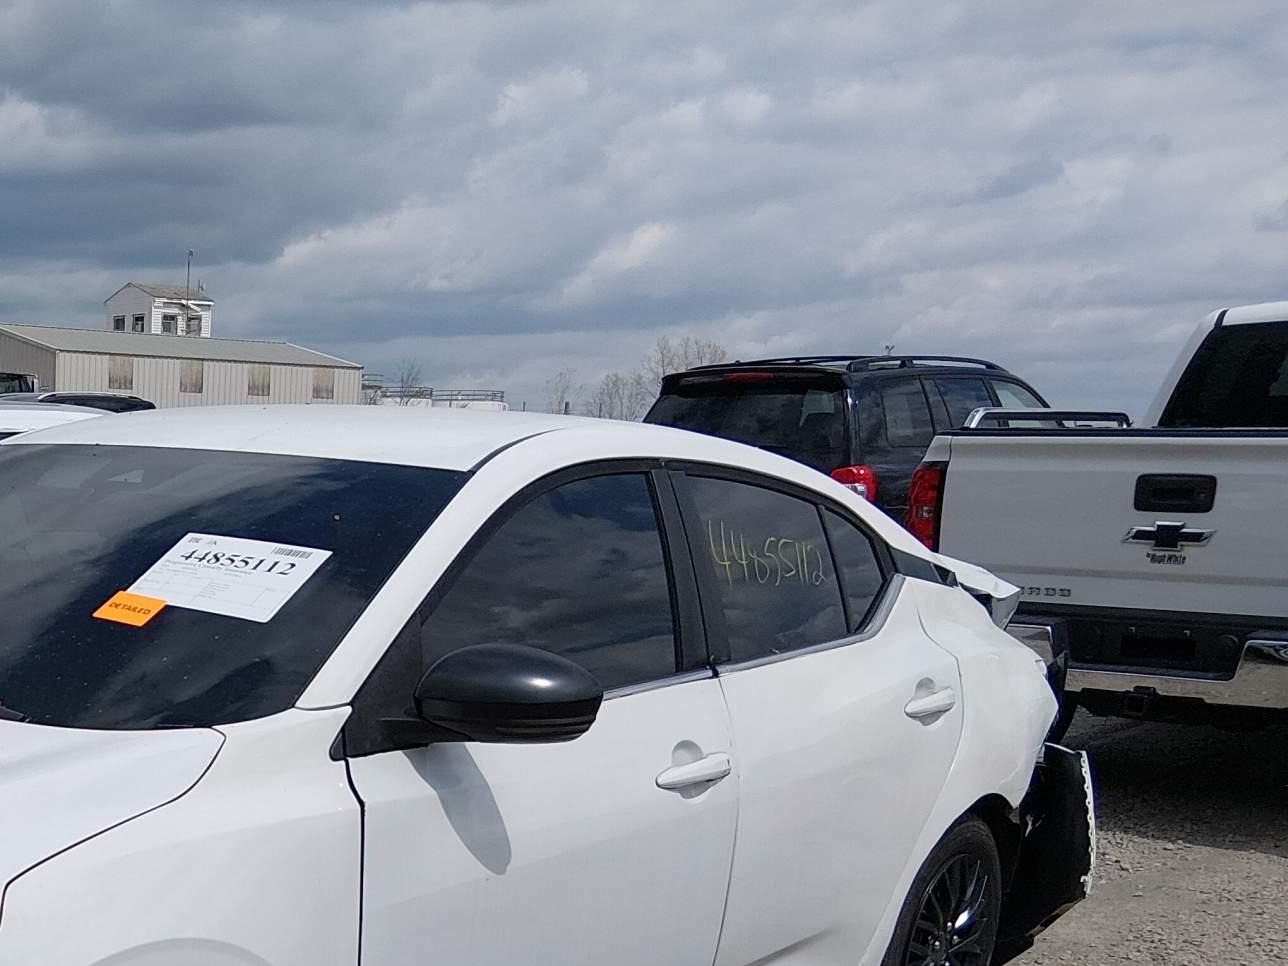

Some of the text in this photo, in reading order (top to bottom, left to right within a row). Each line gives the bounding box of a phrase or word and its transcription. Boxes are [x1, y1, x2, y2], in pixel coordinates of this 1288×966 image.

[180, 549, 296, 576] 44855112
[709, 520, 826, 586] 44855112
[108, 601, 152, 616] DETAILED
